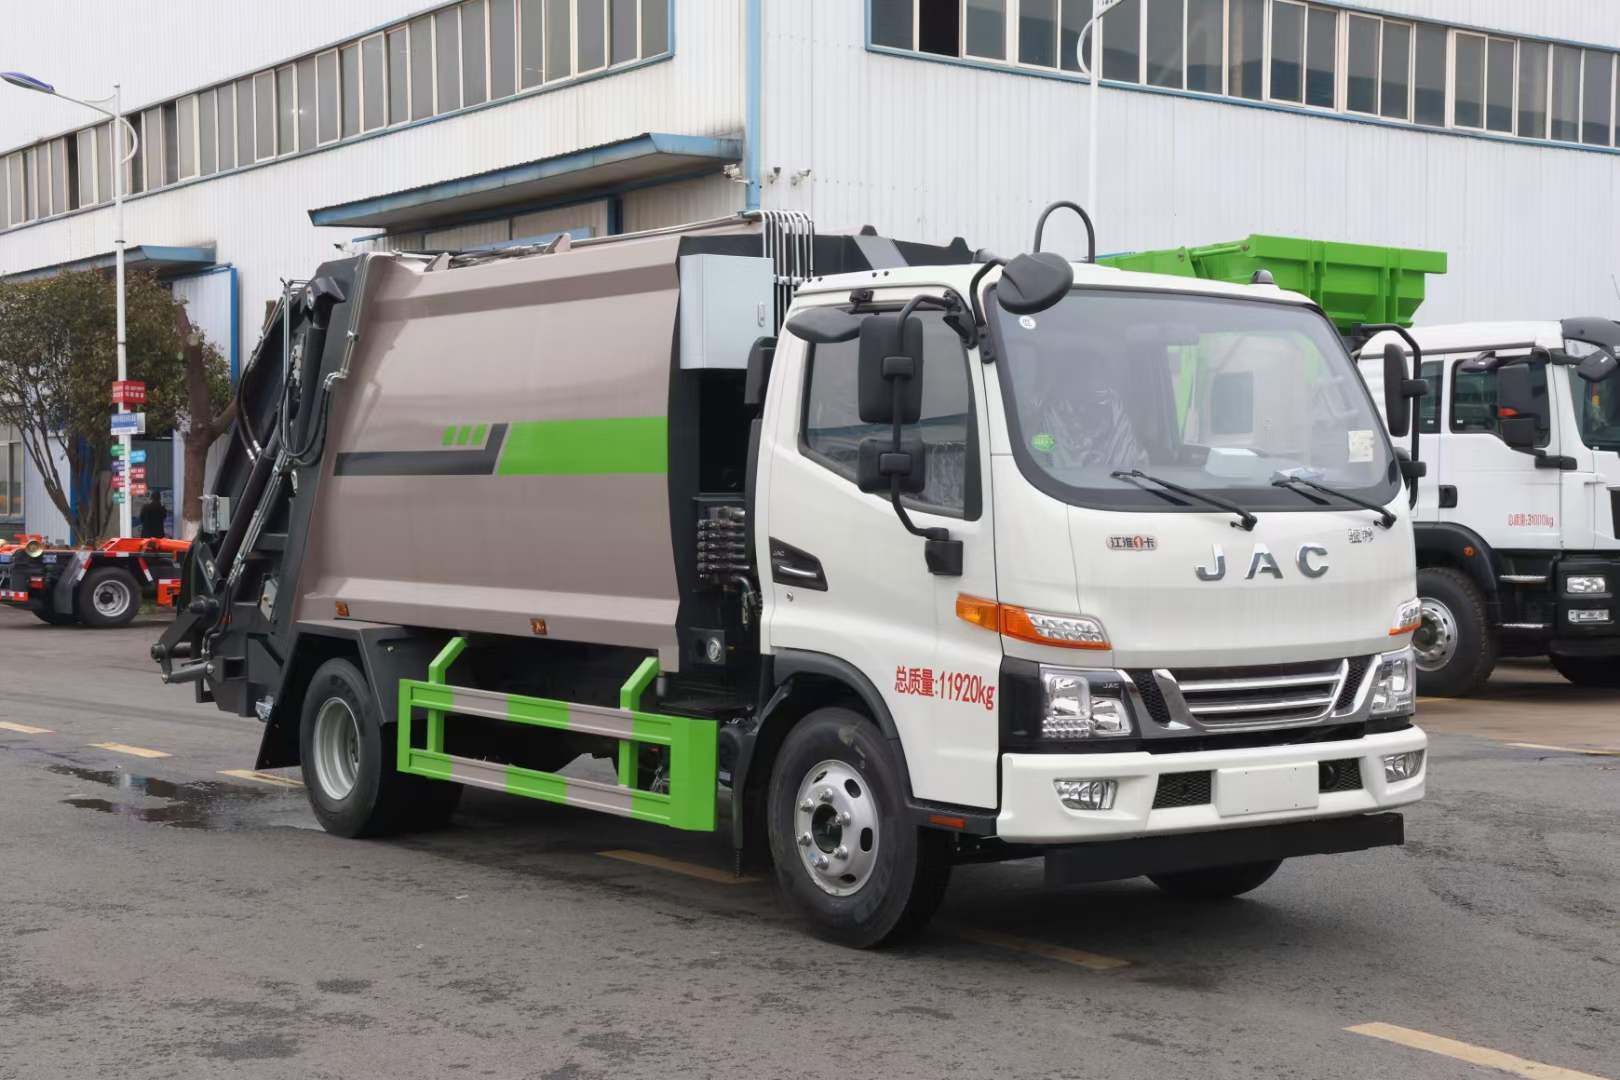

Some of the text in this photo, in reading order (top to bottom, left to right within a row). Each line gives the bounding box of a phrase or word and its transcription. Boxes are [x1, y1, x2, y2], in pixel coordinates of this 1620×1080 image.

[1194, 542, 1329, 581] JAC
[894, 665, 996, 711] 总质量:11920kg
